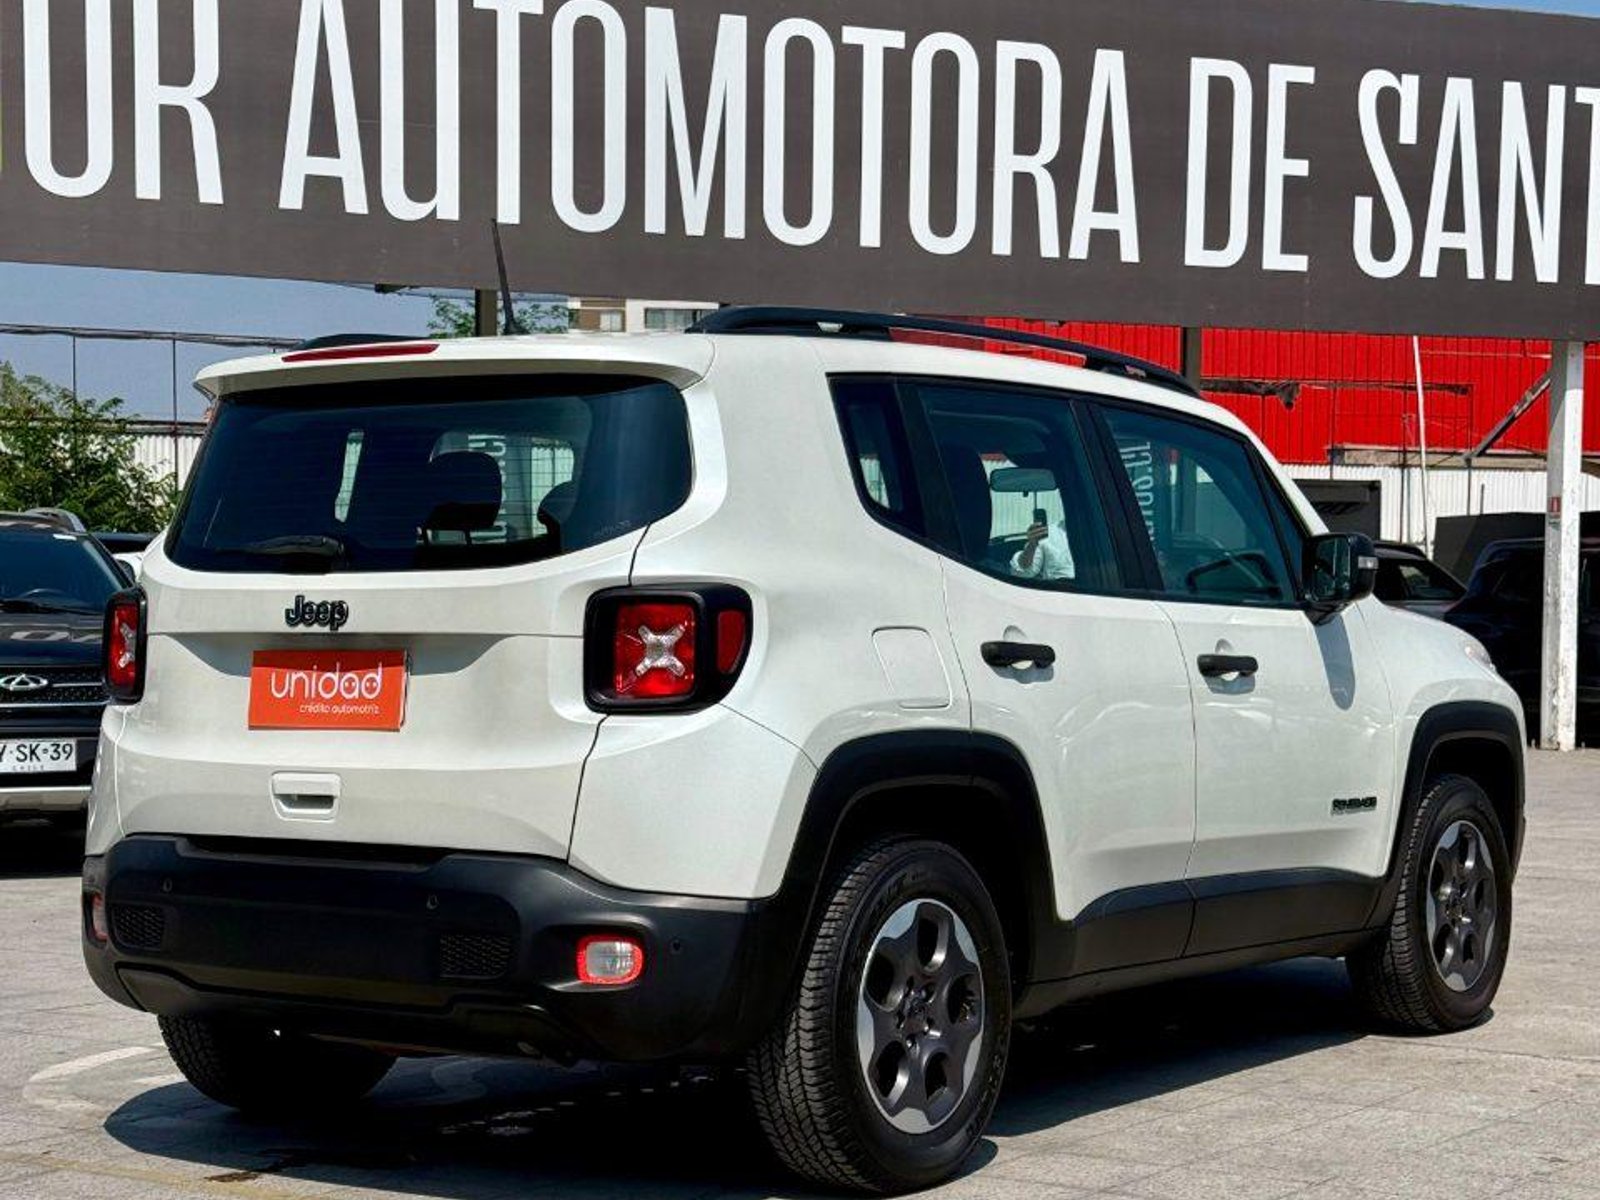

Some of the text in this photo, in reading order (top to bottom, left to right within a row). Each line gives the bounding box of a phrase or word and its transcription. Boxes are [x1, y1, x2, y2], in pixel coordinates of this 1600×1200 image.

[278, 0, 1141, 263] AUTOMOTORA
[1184, 57, 1316, 272] DE
[285, 595, 349, 631] Jeep
[271, 662, 382, 699] unidad
